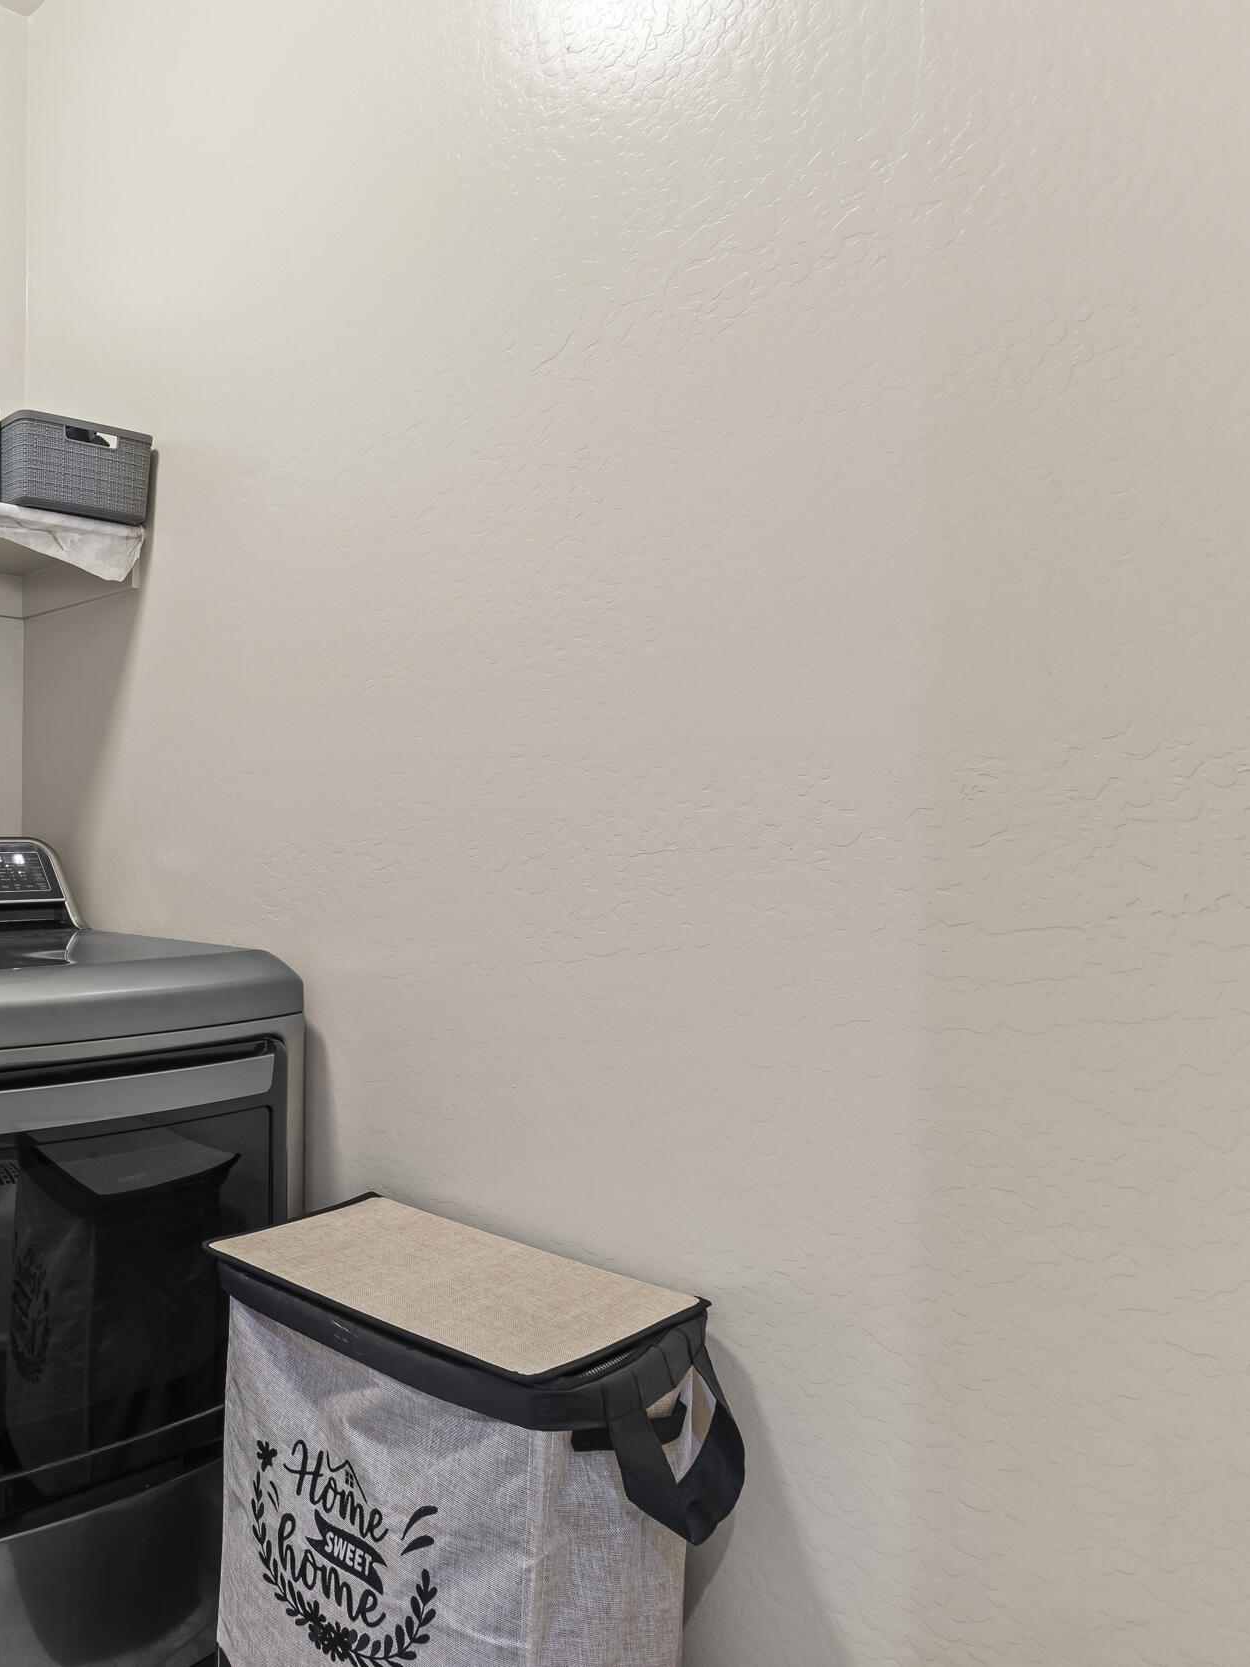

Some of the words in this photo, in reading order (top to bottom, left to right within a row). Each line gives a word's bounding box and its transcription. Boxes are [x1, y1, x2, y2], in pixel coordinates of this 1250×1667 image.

[283, 1439, 389, 1543] Home
[277, 1512, 387, 1628] home
[324, 1531, 373, 1577] SWEET
